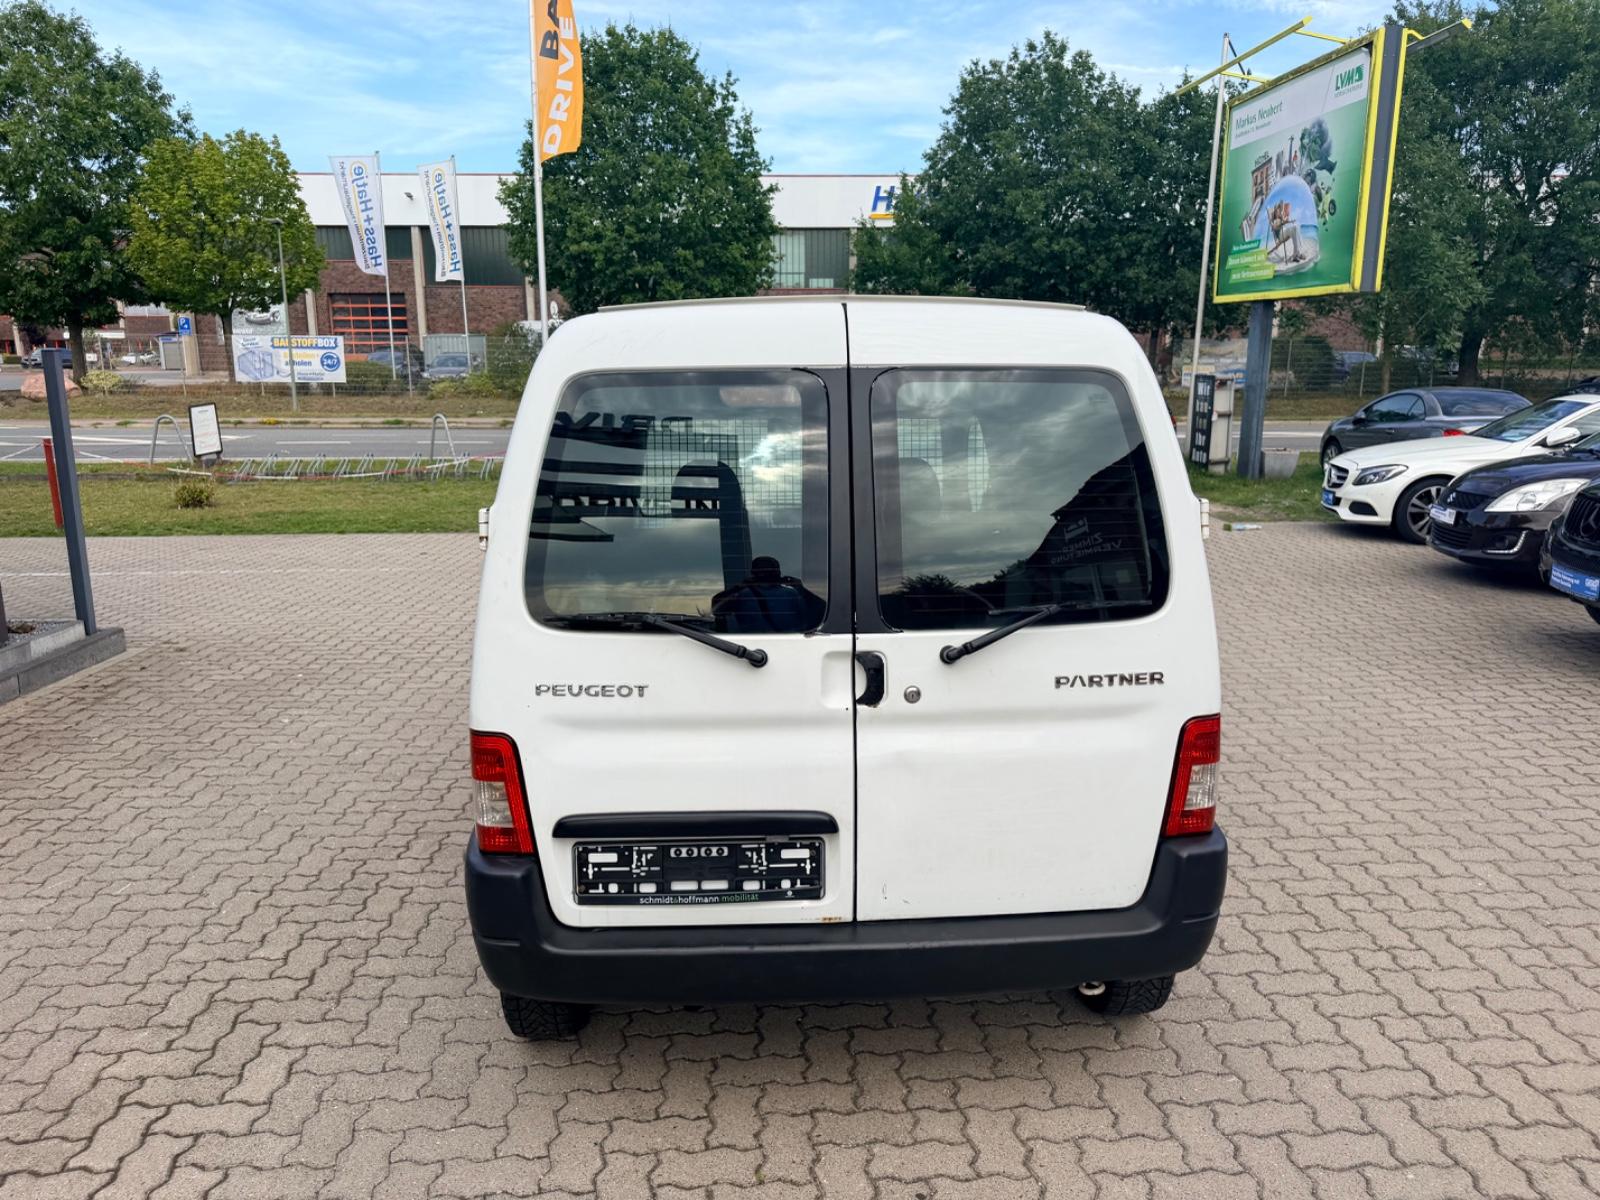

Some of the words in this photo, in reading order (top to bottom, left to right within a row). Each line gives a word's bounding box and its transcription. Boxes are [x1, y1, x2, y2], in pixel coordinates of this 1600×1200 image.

[543, 16, 574, 155] DRIVE
[1335, 67, 1355, 92] LVM
[535, 684, 649, 698] PEUGEOT
[1055, 672, 1164, 689] PARTNER
